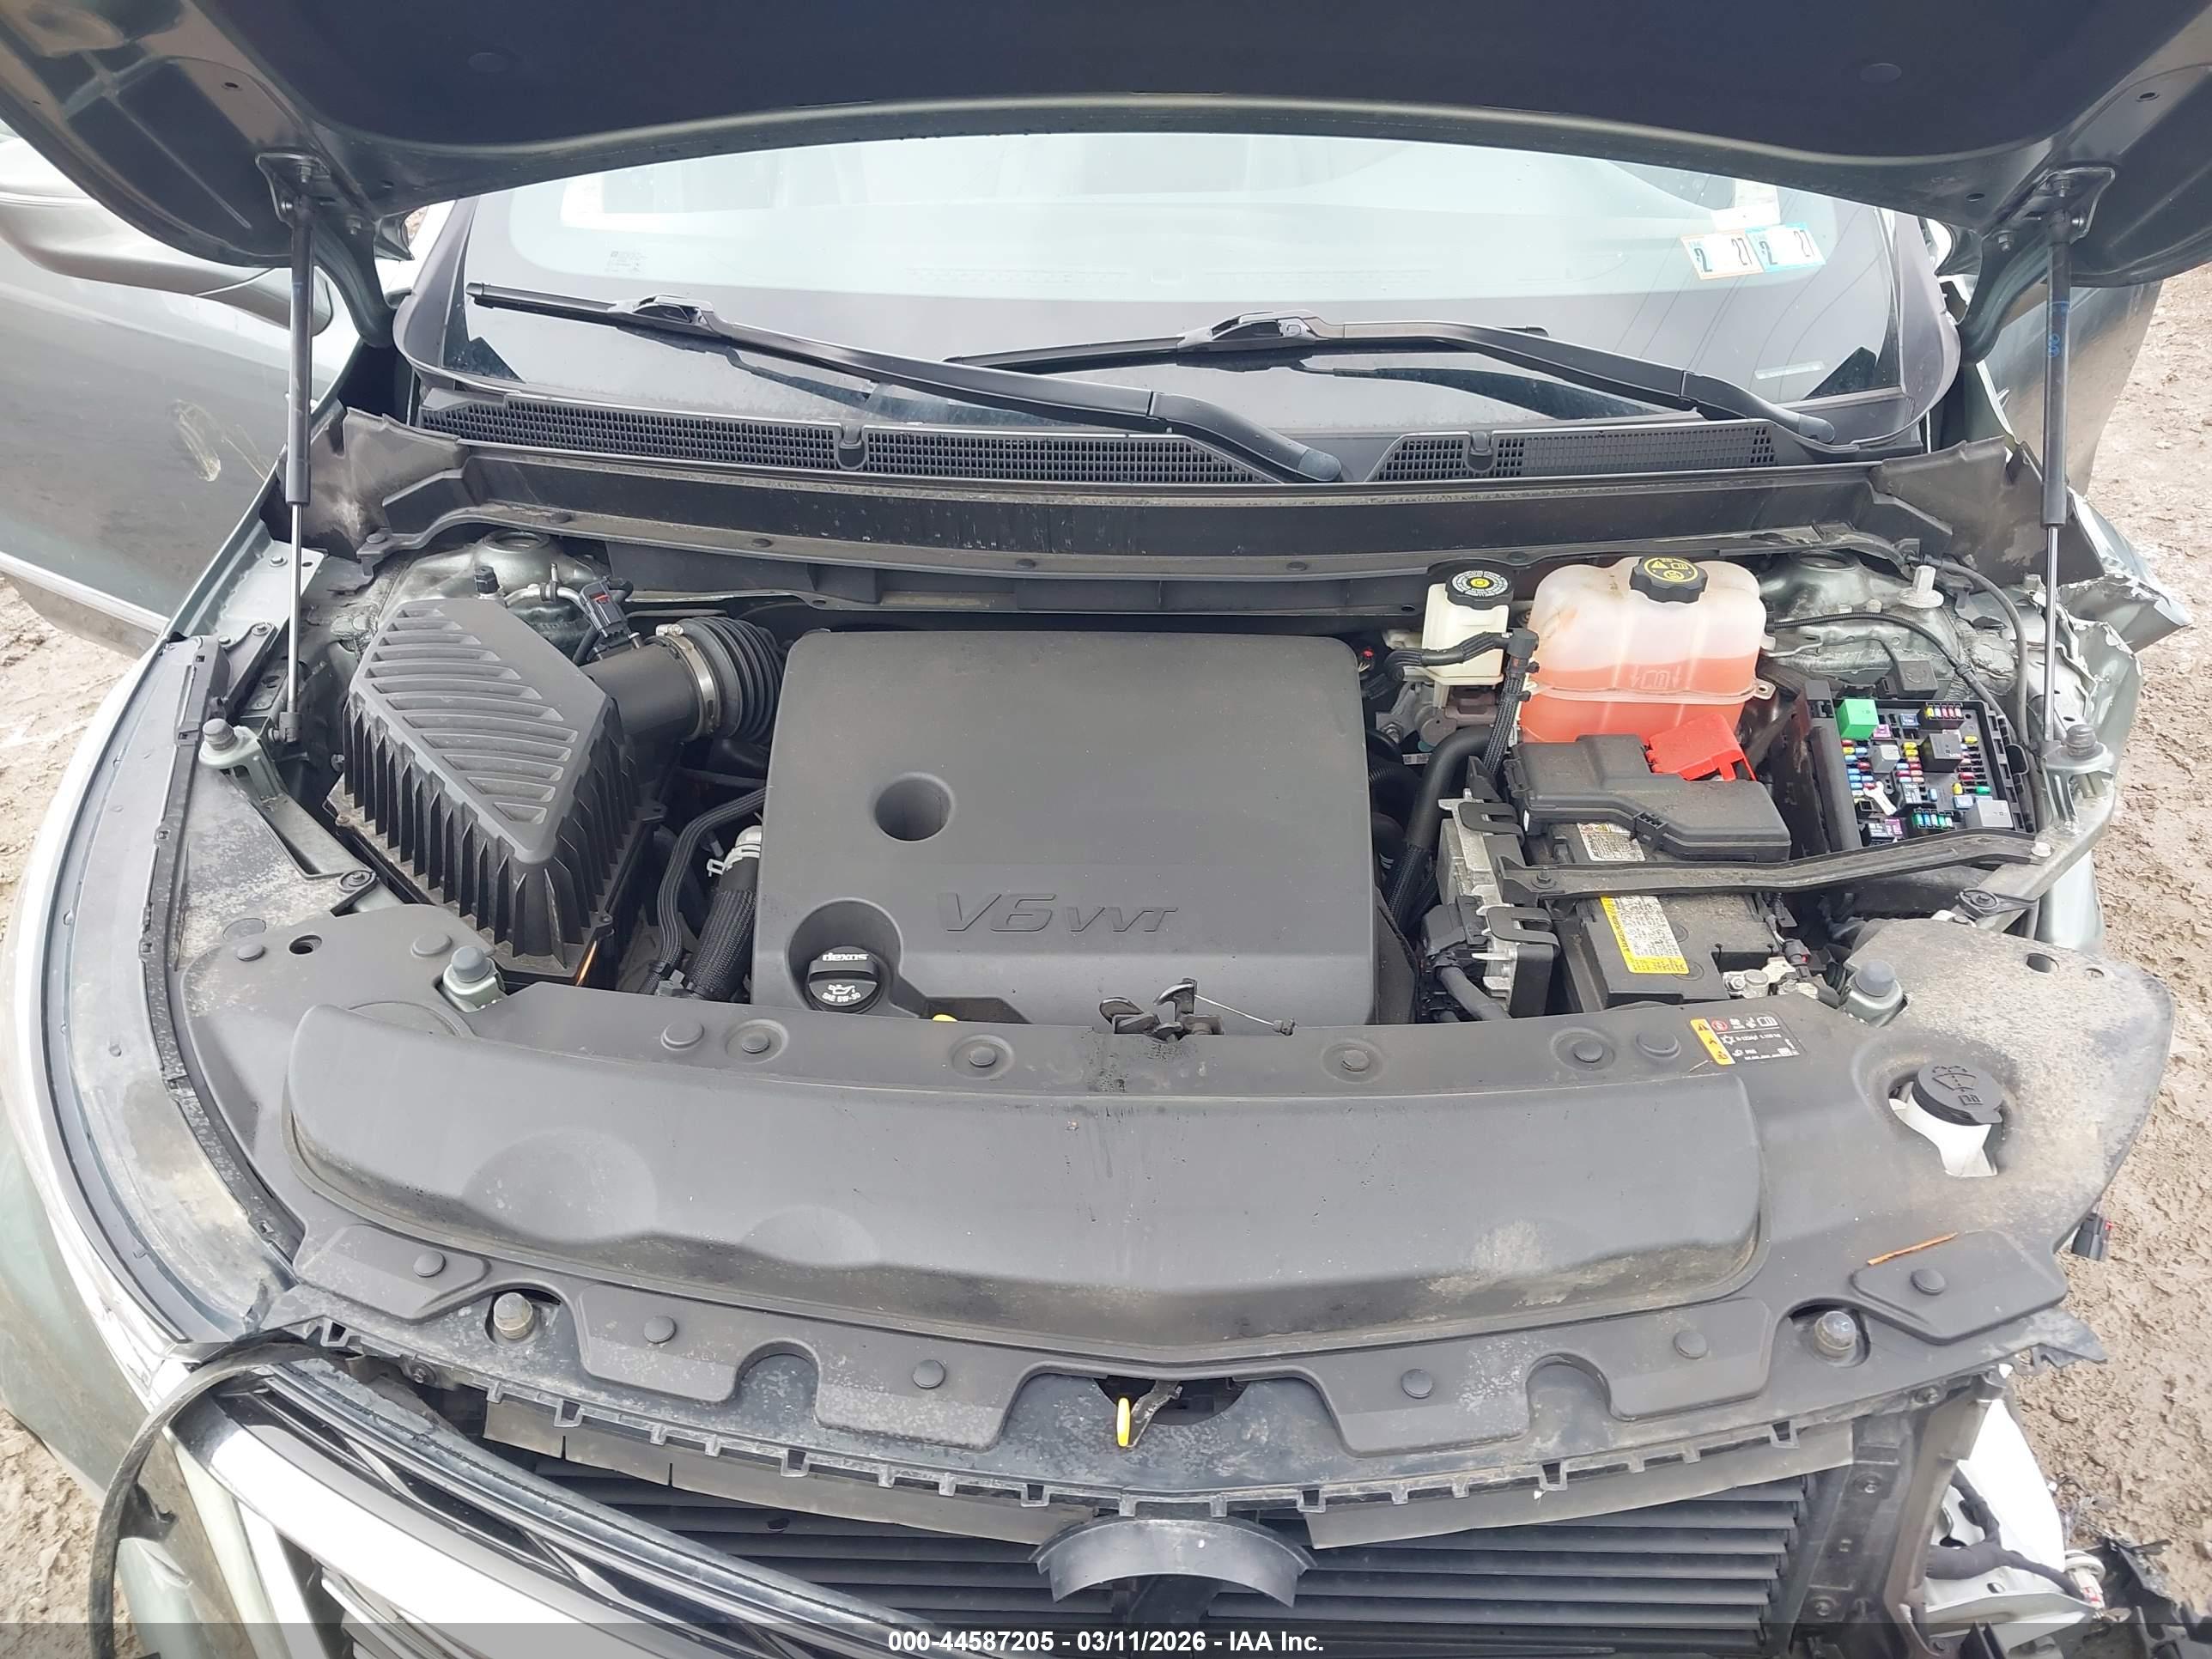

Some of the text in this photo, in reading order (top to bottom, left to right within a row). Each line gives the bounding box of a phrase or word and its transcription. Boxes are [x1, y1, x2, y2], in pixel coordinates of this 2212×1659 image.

[1694, 237, 1753, 273] 2 27
[1759, 229, 1815, 265] 2 27
[937, 892, 1178, 933] V6 VVT
[822, 952, 869, 961] dexos
